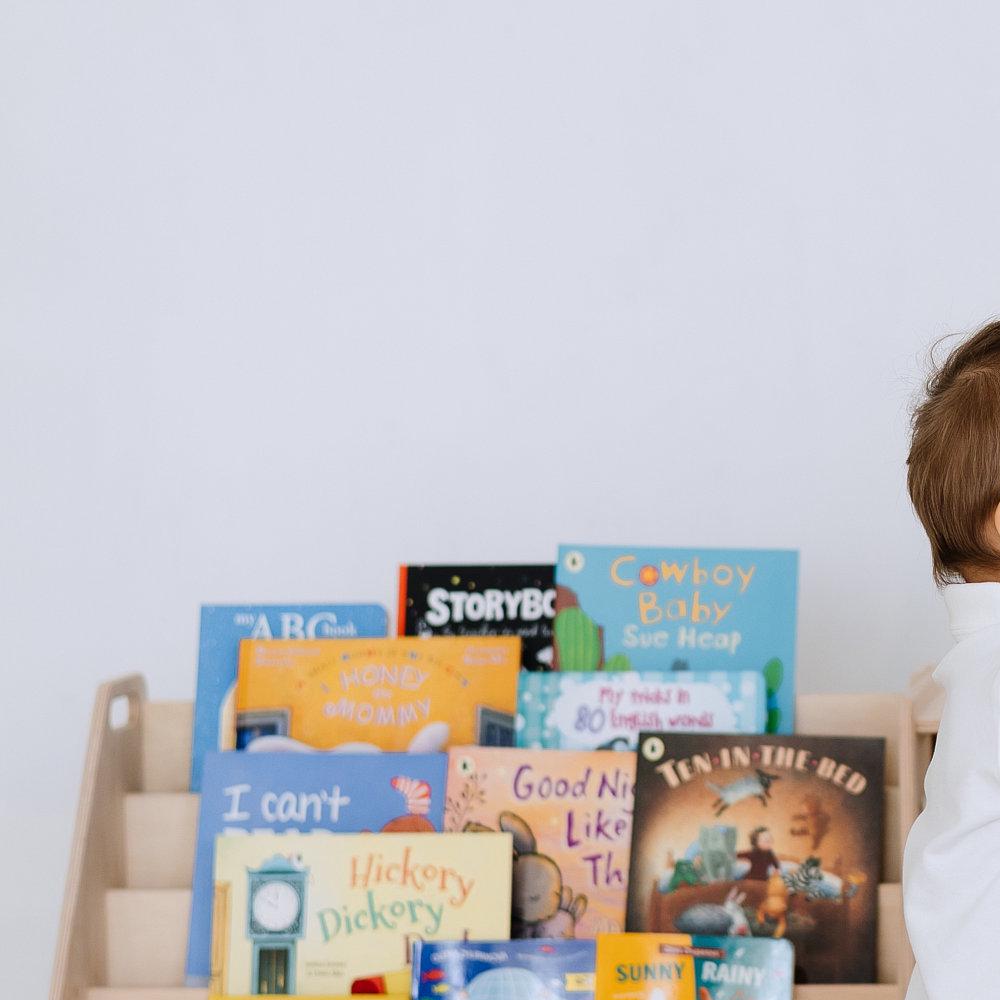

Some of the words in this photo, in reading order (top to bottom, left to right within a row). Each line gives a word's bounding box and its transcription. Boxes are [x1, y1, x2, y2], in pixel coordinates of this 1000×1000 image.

[610, 554, 756, 593] Cowboy
[638, 590, 732, 625] Baby
[622, 623, 669, 649] Sue
[676, 624, 742, 655] Heap
[574, 704, 606, 733] 80
[512, 765, 593, 801] Good
[655, 752, 713, 789] TEN
[718, 746, 750, 769] IN
[760, 744, 812, 771] THE
[816, 756, 868, 796] BED
[222, 783, 252, 821] I
[566, 808, 628, 848] Like
[349, 846, 476, 910] Hickory
[317, 889, 445, 944] Dickory
[615, 962, 686, 983] SUNNY
[701, 960, 765, 987] RAINY
